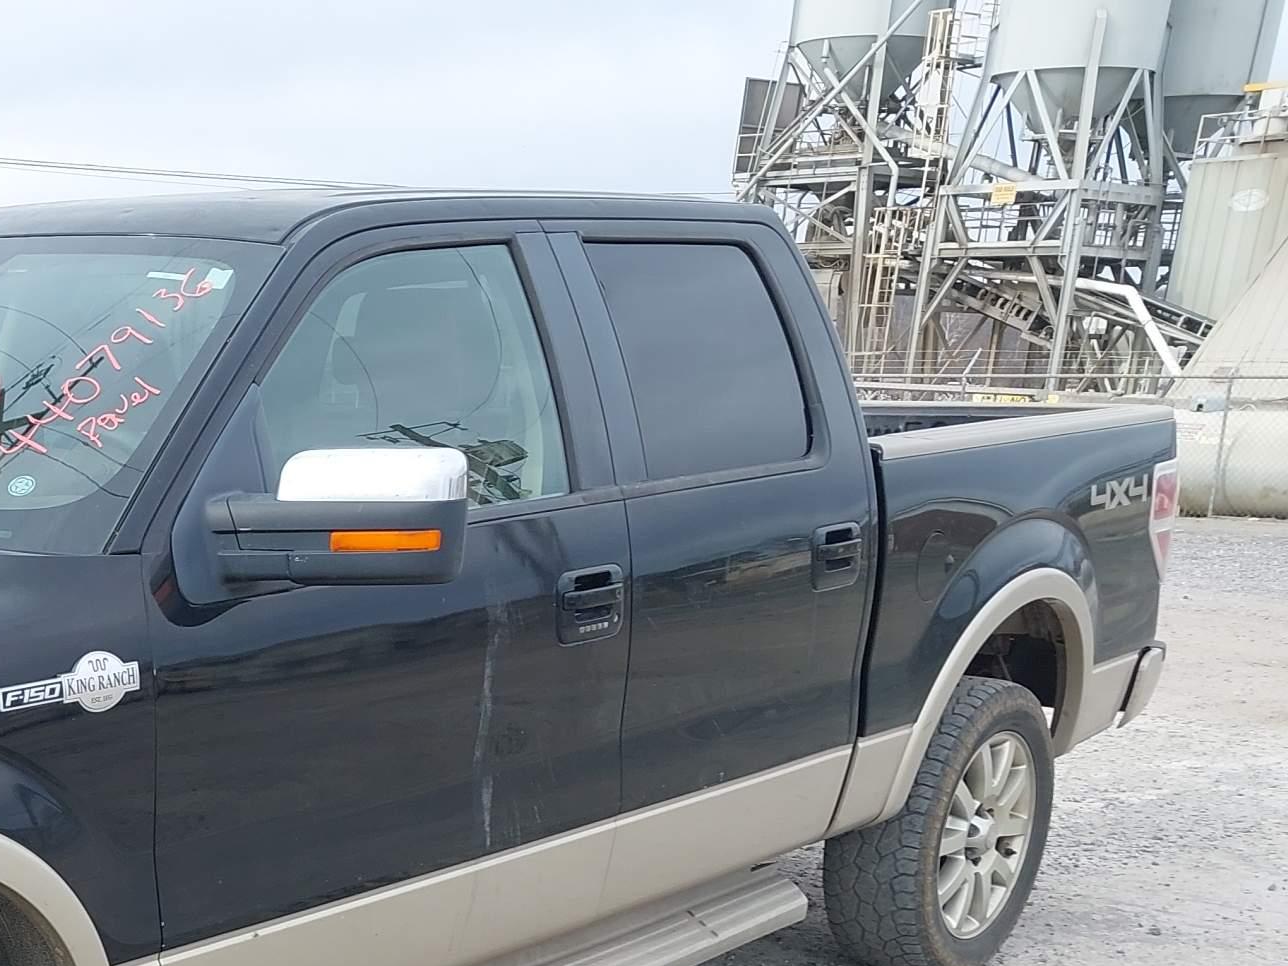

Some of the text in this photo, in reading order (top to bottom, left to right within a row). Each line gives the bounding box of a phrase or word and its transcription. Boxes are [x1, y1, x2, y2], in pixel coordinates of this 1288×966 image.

[5, 683, 61, 707] F-150
[66, 667, 137, 697] KING RANCH
